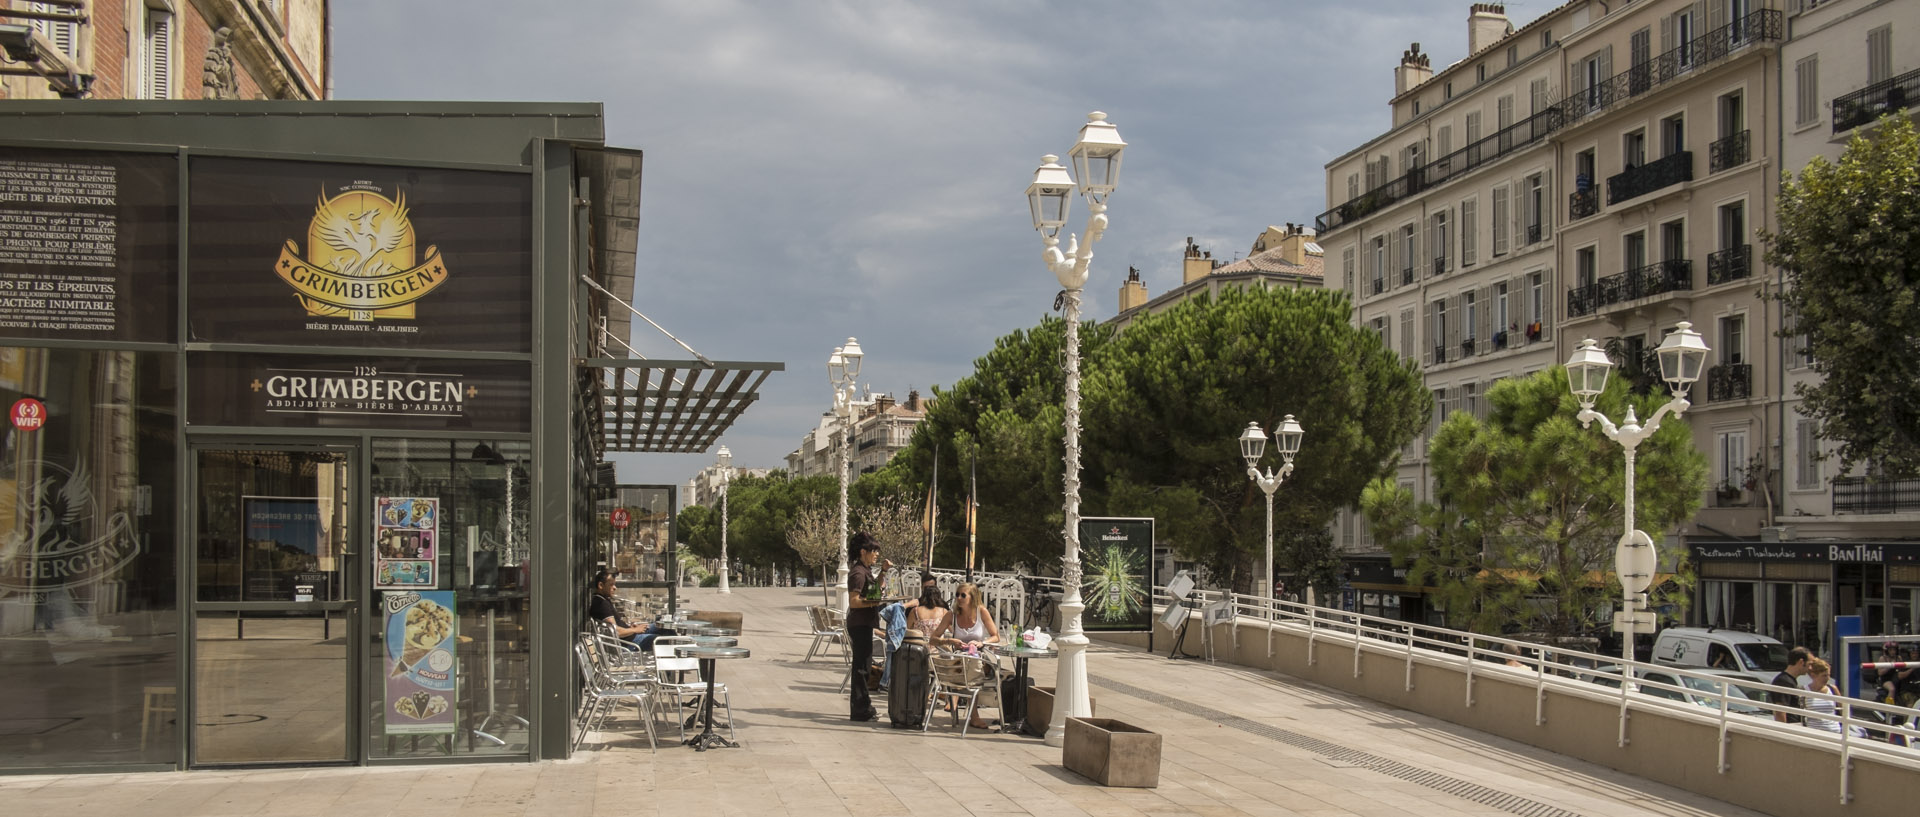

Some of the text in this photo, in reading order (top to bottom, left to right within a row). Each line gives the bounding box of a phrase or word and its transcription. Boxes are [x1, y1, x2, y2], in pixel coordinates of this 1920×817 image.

[30, 194, 44, 202] DE
[24, 232, 78, 240] GRIMBERGEN
[44, 240, 70, 248] POUR
[16, 281, 32, 290] ET
[34, 282, 54, 291] LES
[58, 280, 116, 294] ÉPREUVES,
[290, 264, 434, 299] GRIMBERGEN
[50, 299, 116, 310] INIMITABLE.
[352, 311, 372, 320] 1128
[305, 321, 330, 330] BIÈRE
[331, 323, 370, 332] D'ABBAYE
[377, 324, 419, 334] ABDIJBIER
[354, 366, 377, 376] 1128
[266, 376, 464, 402] GRIMBERGEN
[267, 400, 337, 408] ABDIJBIER
[356, 400, 394, 410] BIÈRE
[402, 403, 462, 412] D'ABBAYE
[16, 416, 41, 427] WIFI
[1696, 546, 1742, 558] Restaurant
[386, 594, 421, 614] Cornetto
[418, 670, 446, 680] NOUVEAU
